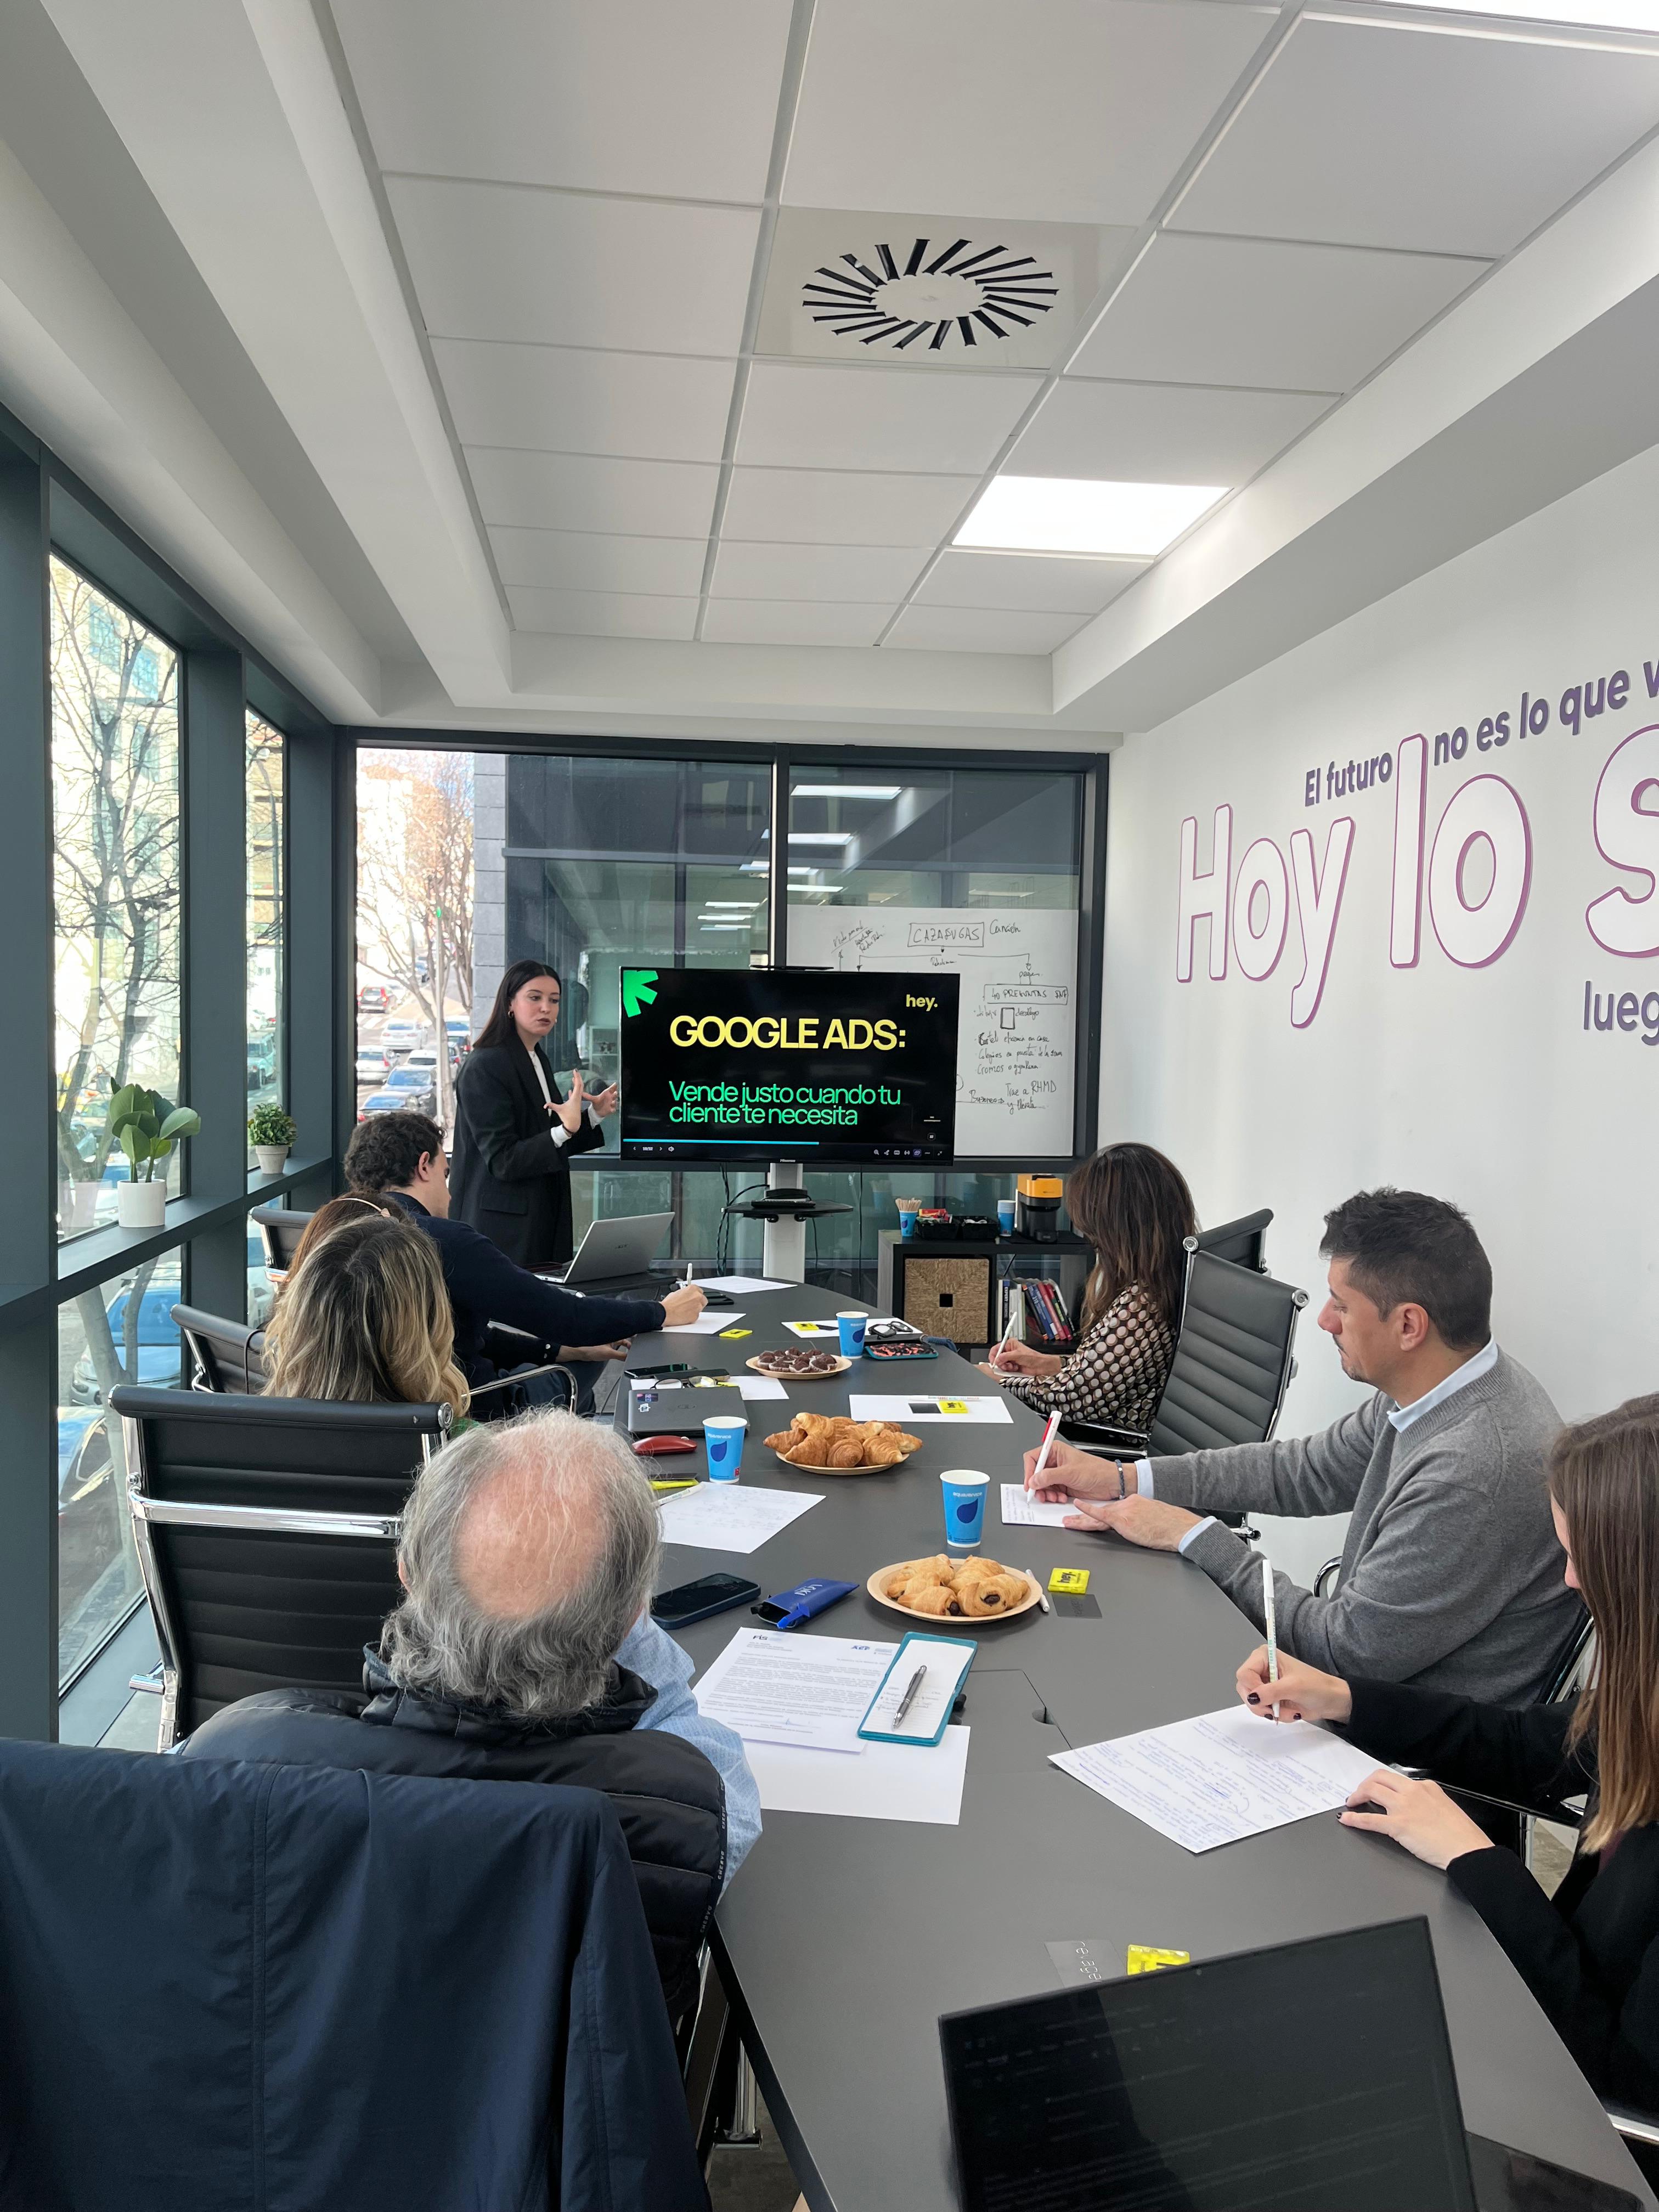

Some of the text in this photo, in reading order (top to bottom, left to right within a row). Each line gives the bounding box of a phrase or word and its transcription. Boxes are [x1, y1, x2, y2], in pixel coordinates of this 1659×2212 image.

[1305, 768, 1321, 806] El
[1327, 752, 1392, 800] futuro
[1434, 725, 1469, 766] no
[1476, 711, 1510, 751] es
[1519, 691, 1549, 740] lo
[1560, 670, 1630, 736] que
[1176, 803, 1356, 1029] Hoy
[1390, 733, 1533, 969] lo
[906, 994, 938, 1011] hey.
[1003, 990, 1047, 998] PREGUNTAS
[1583, 980, 1659, 1046] lueg
[670, 1015, 906, 1051] GOOGLE ADS:
[669, 1081, 901, 1108] Vende justo cuando tu
[1005, 1082, 1019, 1097] Trae
[669, 1102, 858, 1125] cliente te necesita
